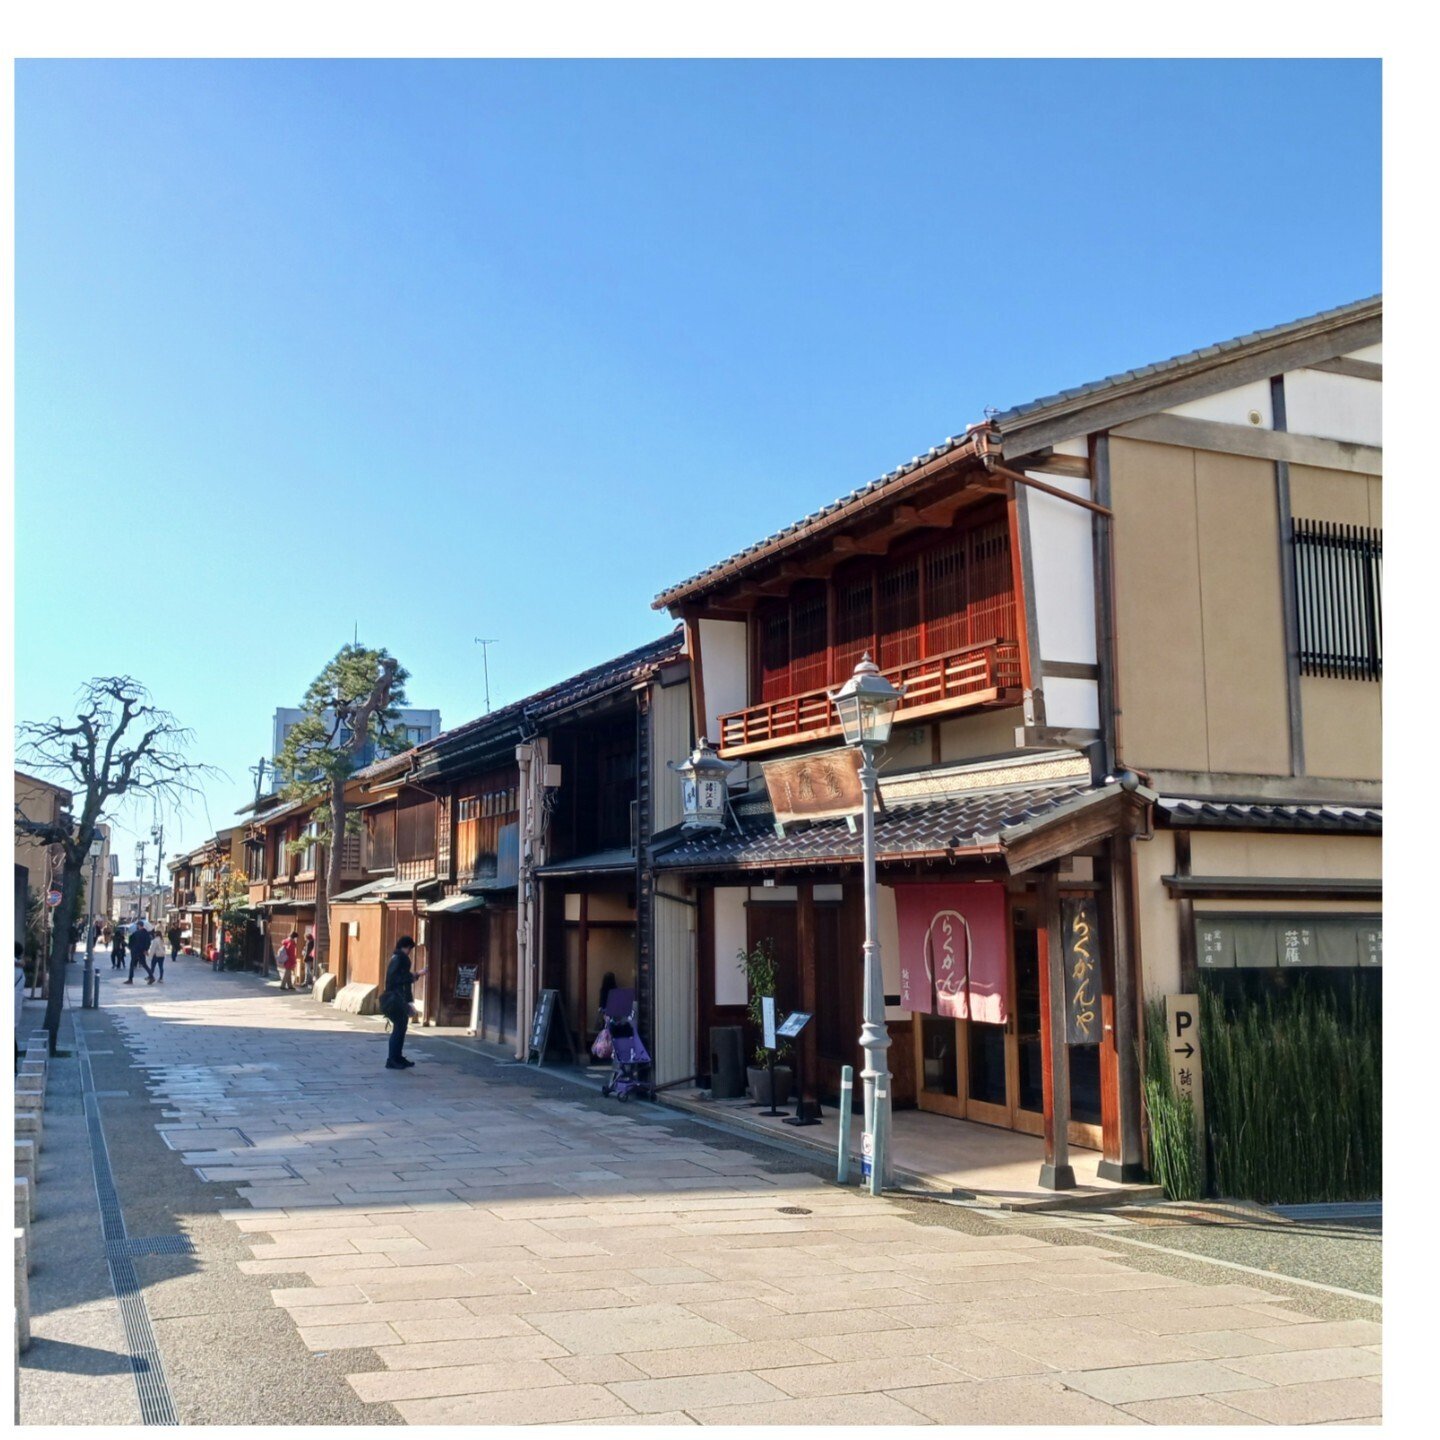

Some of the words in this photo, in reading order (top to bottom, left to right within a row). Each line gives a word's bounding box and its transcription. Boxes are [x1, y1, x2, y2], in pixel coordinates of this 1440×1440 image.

[941, 915, 958, 993] らくがん
[1072, 911, 1096, 1035] らくがんや
[1284, 930, 1302, 963] 落雁
[1175, 1011, 1193, 1037] P
